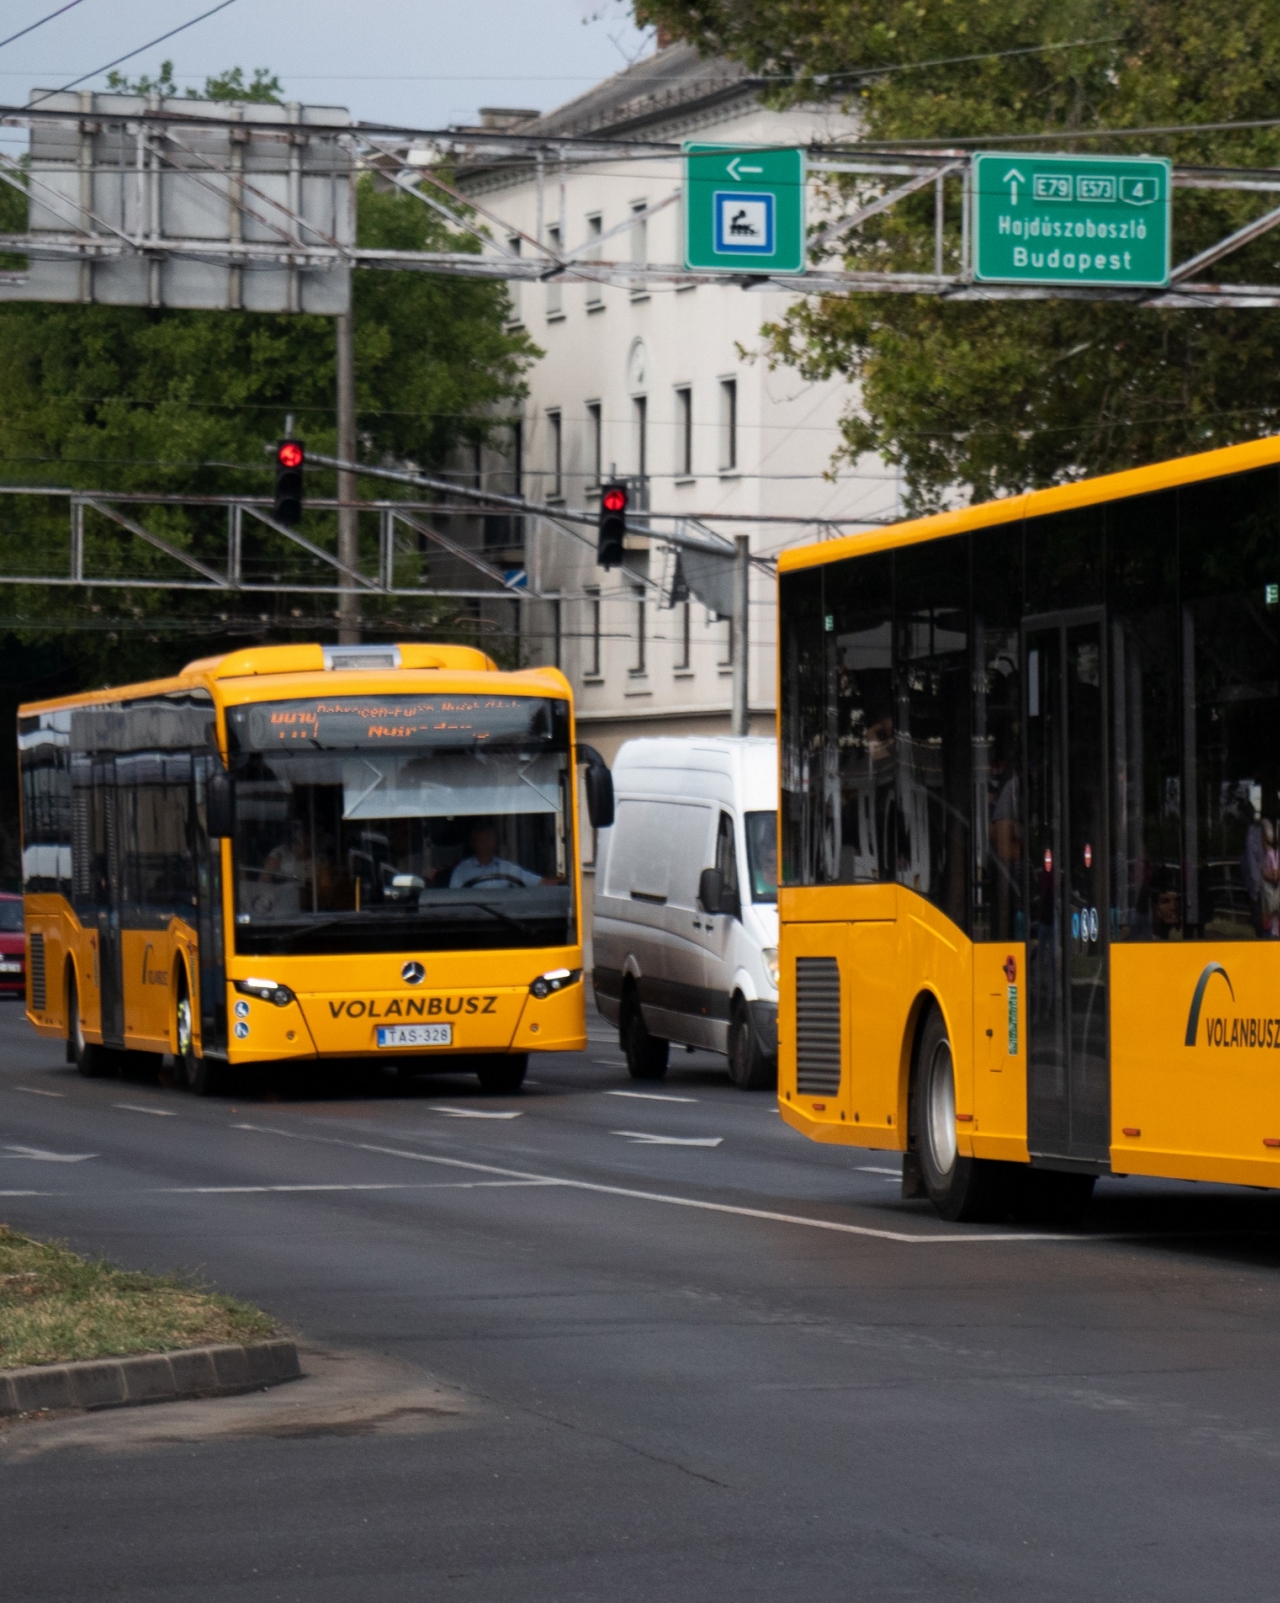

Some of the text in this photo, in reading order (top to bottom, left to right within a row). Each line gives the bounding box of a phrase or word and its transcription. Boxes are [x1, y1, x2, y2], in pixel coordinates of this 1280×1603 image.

[1037, 178, 1145, 199] E79 E573 4
[999, 215, 1147, 240] Hajdúszoboszló
[1013, 246, 1132, 273] Budapest
[328, 996, 499, 1019] VOLÁNBUSZ
[389, 1029, 448, 1044] TAS-328
